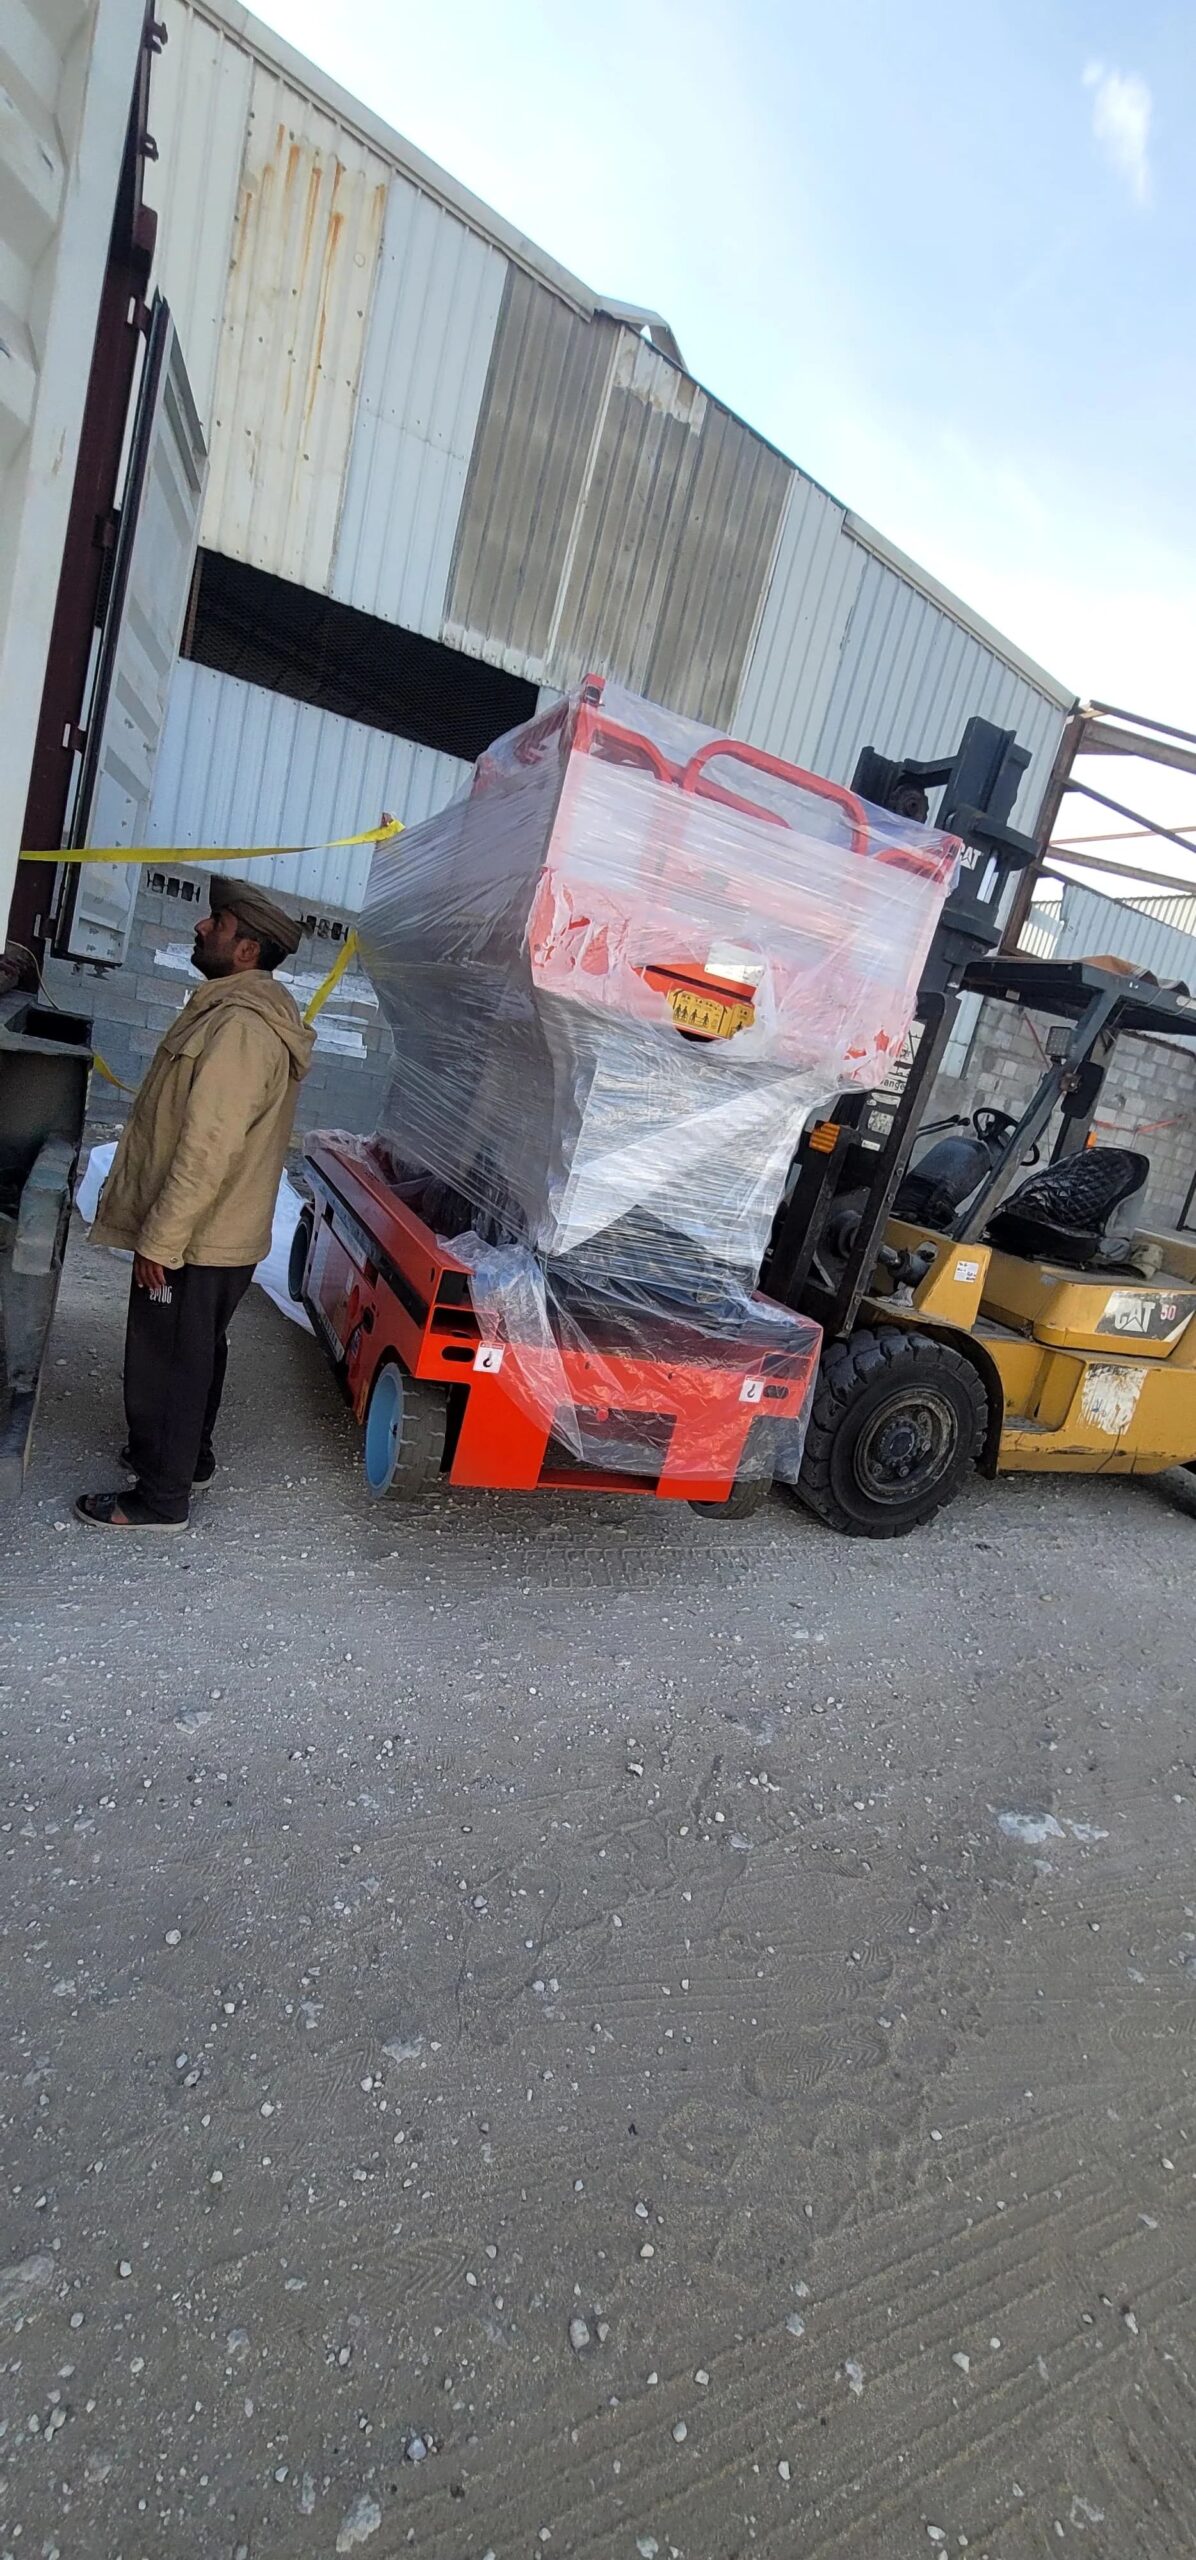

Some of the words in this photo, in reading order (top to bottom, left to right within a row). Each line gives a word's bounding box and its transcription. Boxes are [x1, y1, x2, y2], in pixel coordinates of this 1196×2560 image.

[880, 1079, 906, 1091] ange
[1114, 1297, 1156, 1333] CAT
[1160, 1303, 1177, 1321] 50
